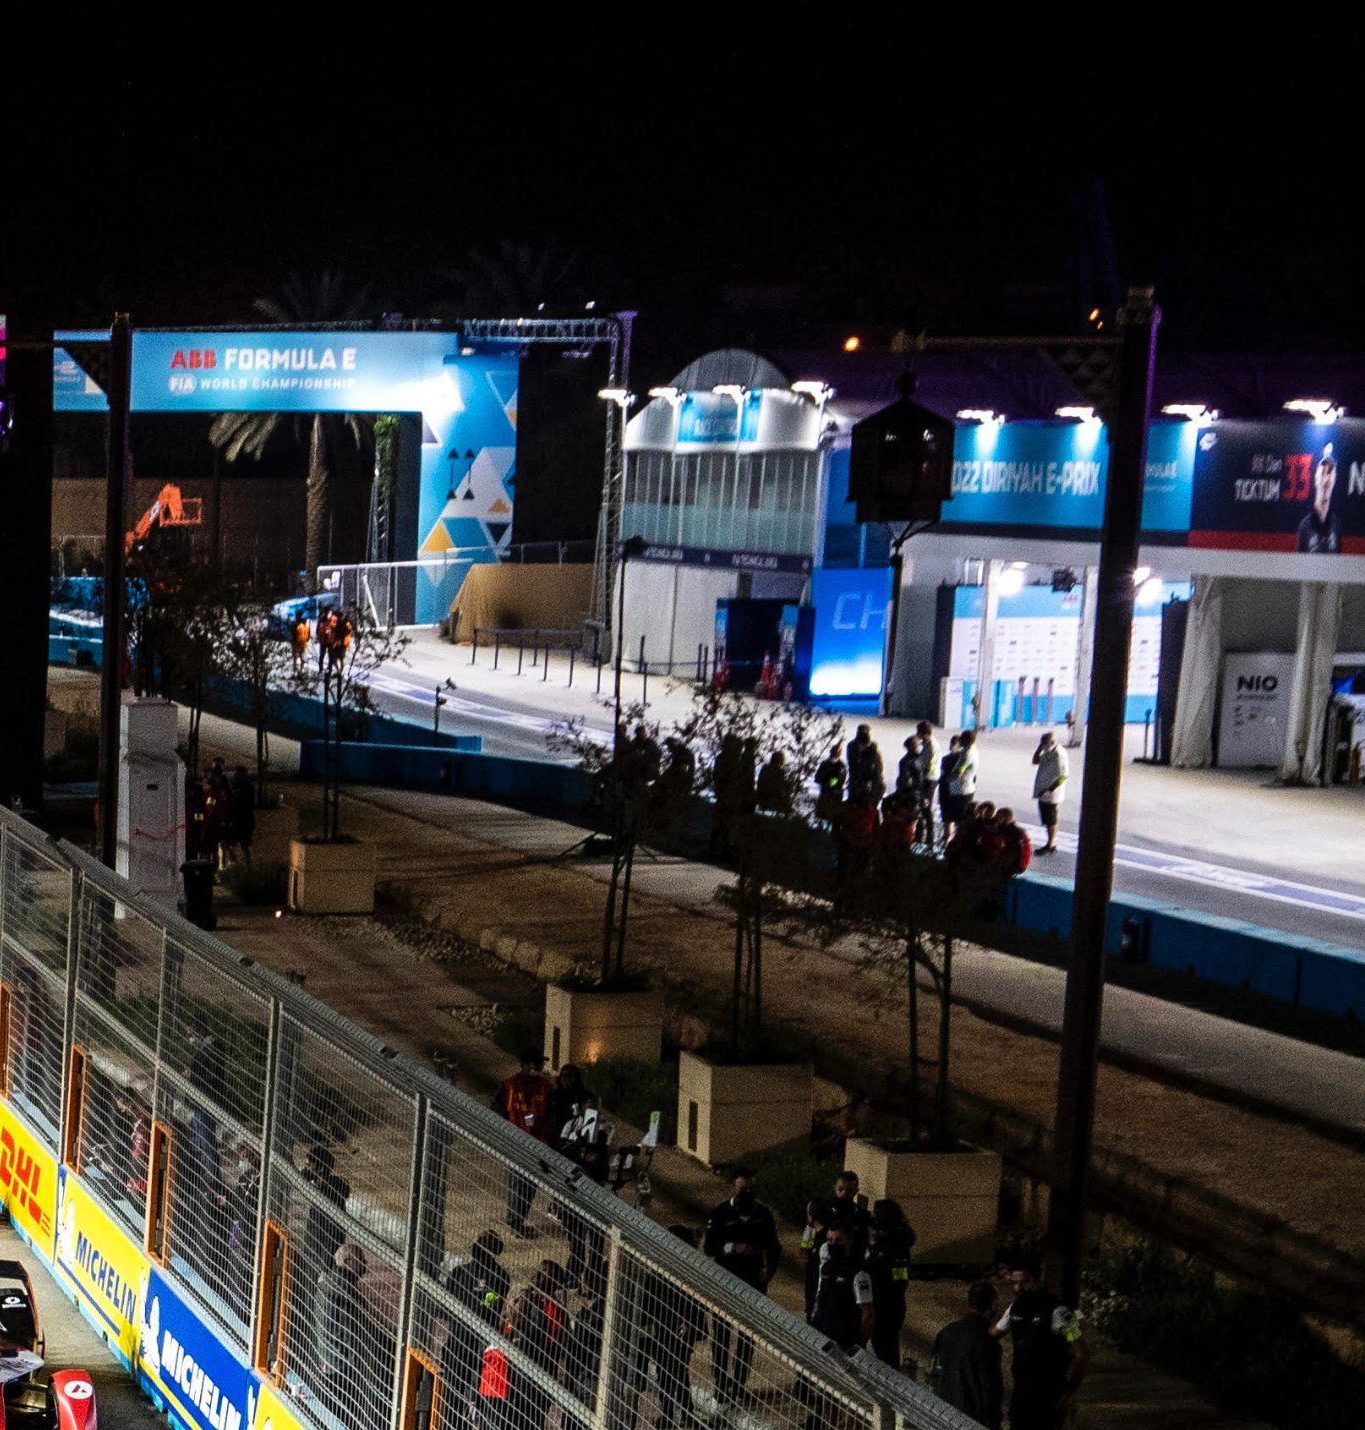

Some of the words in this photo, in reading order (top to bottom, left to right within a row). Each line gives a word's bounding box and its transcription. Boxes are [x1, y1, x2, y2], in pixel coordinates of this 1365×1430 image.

[171, 349, 216, 369] ABB
[223, 348, 336, 370] FORMULA
[341, 347, 357, 369] E
[200, 378, 249, 391] WORLD
[250, 377, 356, 391] CHAMPIONSHIP
[1045, 461, 1099, 496] E-PRIX
[1236, 675, 1279, 693] NIO
[75, 1231, 138, 1325] MICHELIN
